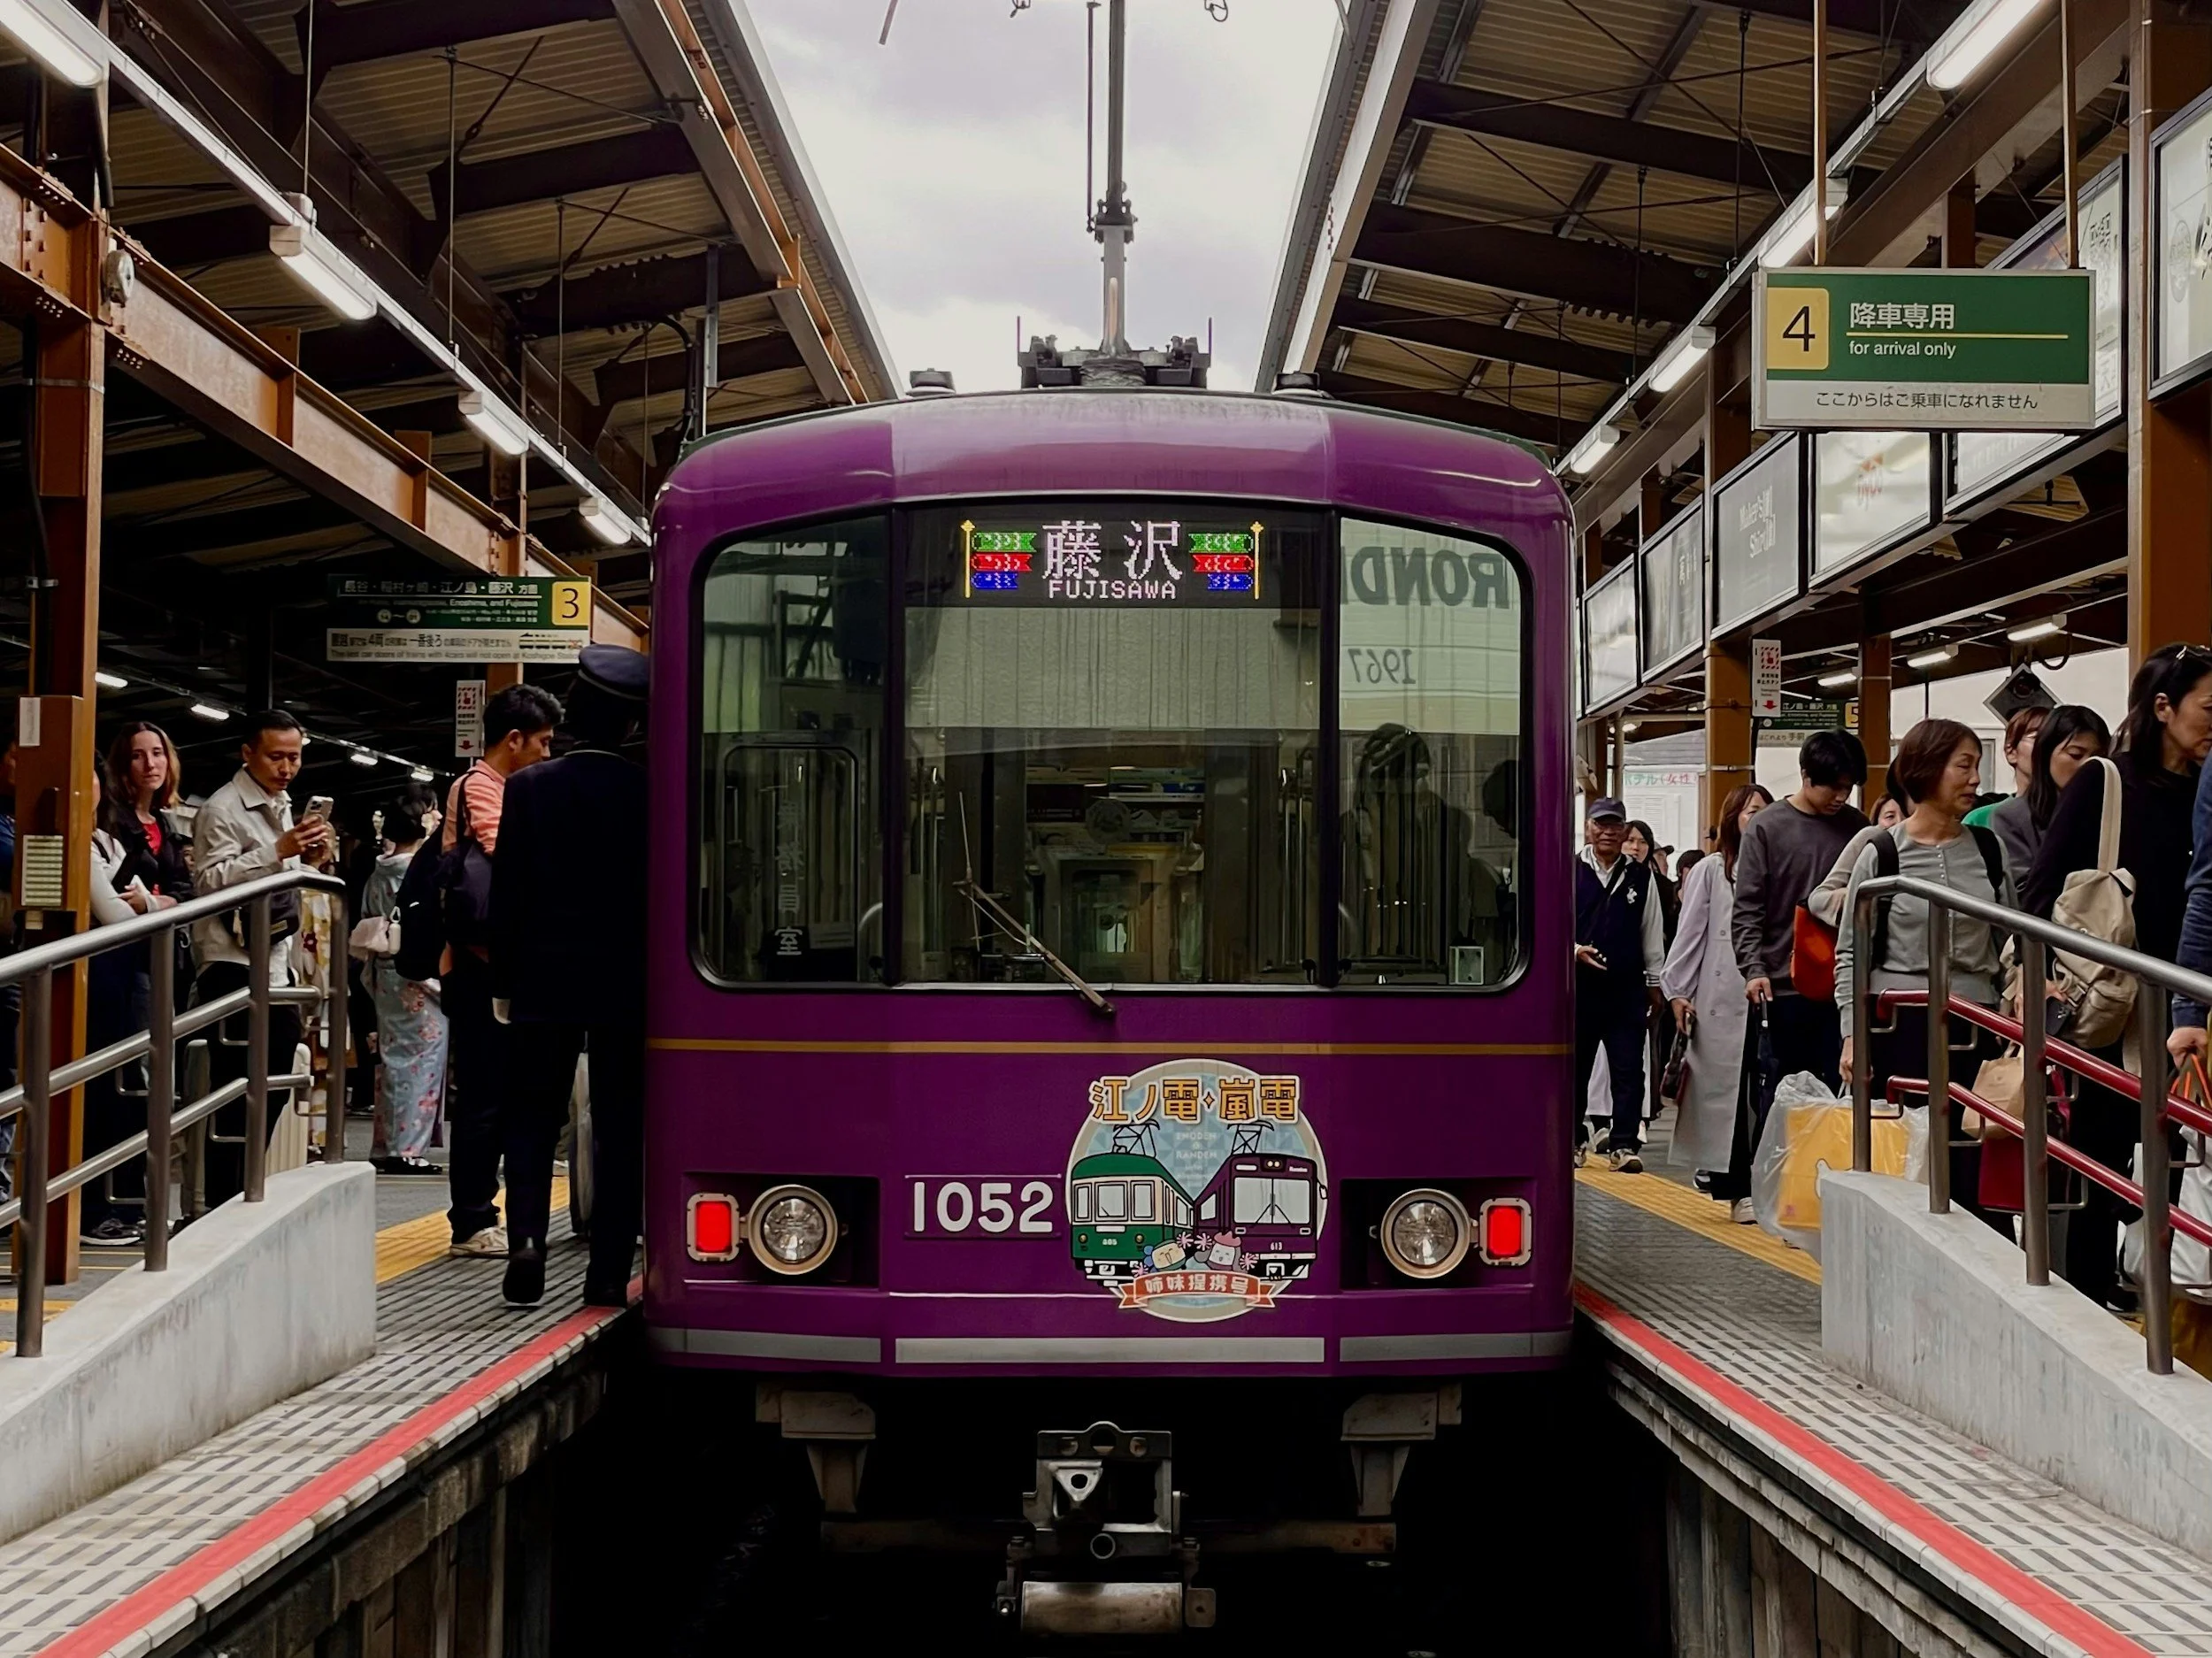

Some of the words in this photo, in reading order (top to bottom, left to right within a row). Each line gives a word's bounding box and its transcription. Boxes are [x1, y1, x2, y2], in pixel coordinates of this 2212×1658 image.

[1782, 305, 1816, 352] 4
[1850, 303, 1955, 330] 降車専用
[1849, 341, 1870, 356] for
[1873, 341, 1920, 356] arrival
[1924, 342, 1956, 358] only
[1816, 391, 2039, 410] ここからはご乗車になれません
[1042, 520, 1182, 580] 藤沢
[562, 588, 580, 618] 3
[1049, 580, 1176, 599] FUJISAWA
[1092, 1078, 1201, 1121] 江ノ電
[914, 1181, 1054, 1233] 1052
